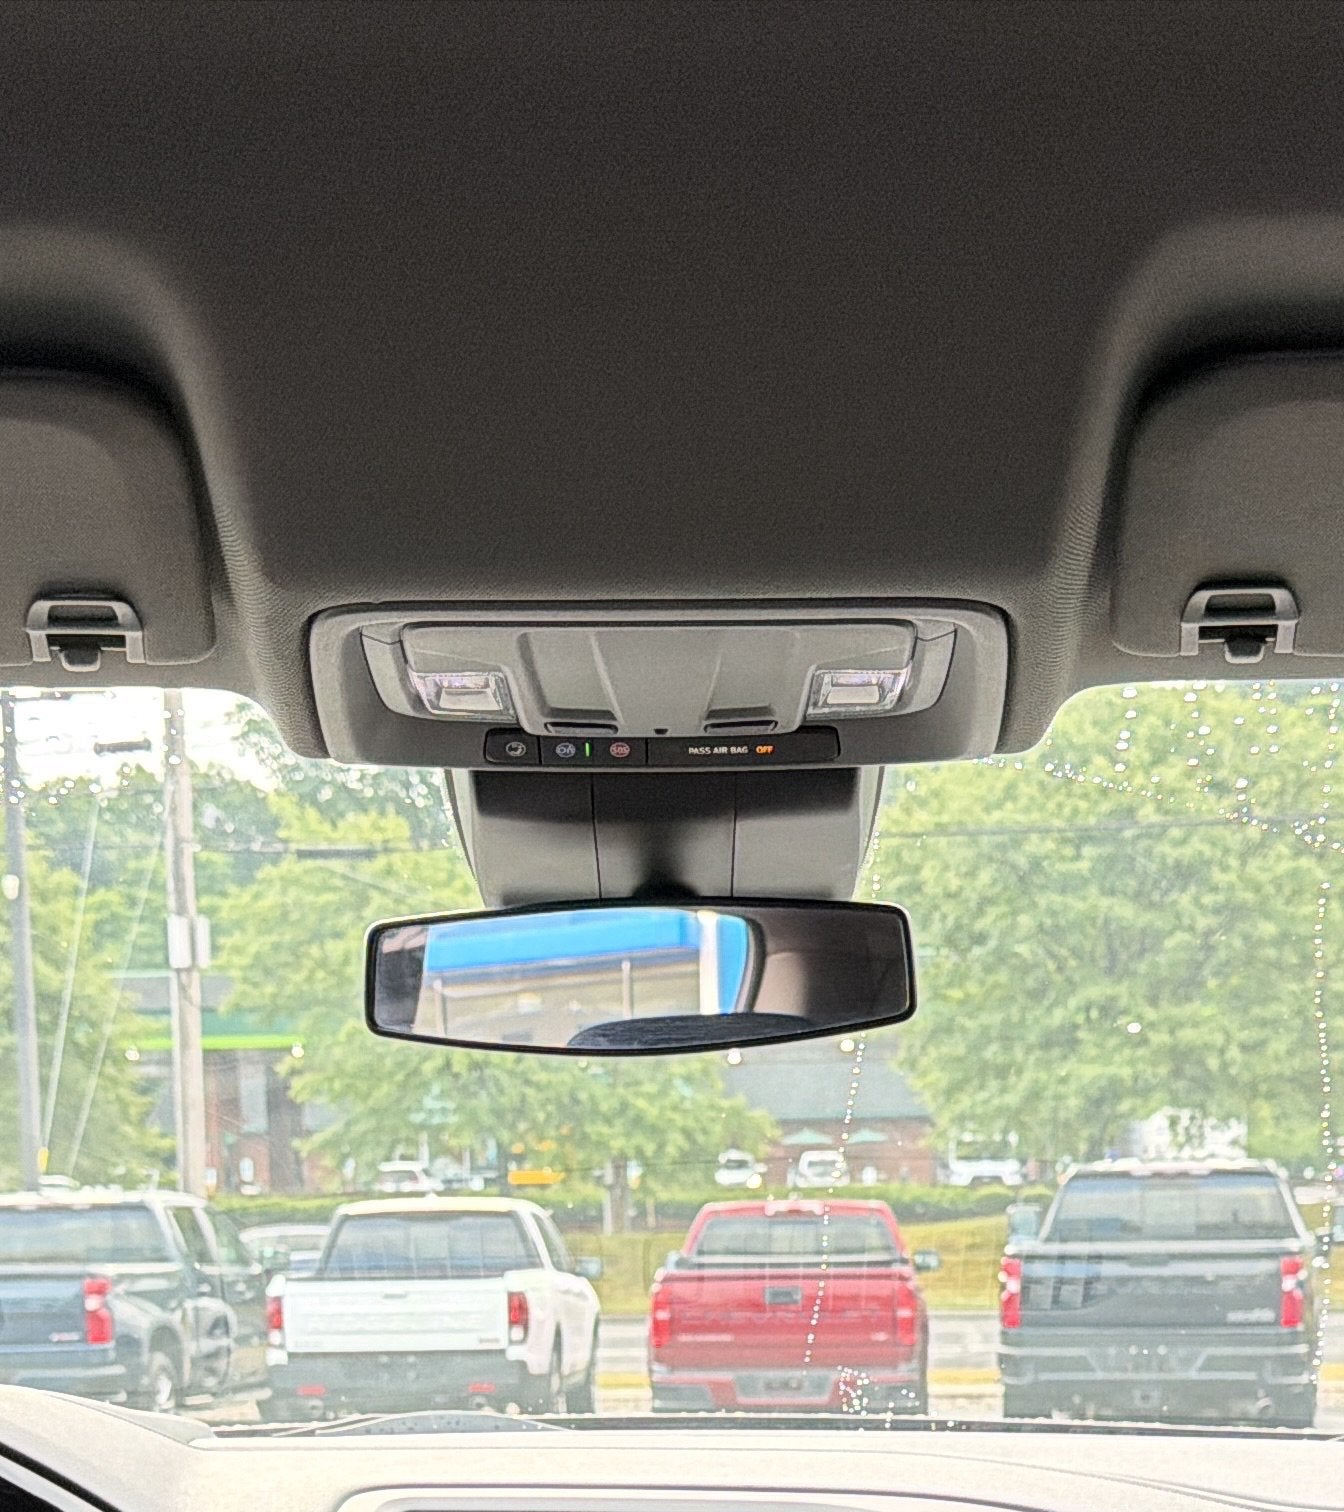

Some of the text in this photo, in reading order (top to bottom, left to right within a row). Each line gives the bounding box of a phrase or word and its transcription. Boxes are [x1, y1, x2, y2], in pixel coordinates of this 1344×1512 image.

[689, 746, 774, 754] PASS AIR BAG OFF
